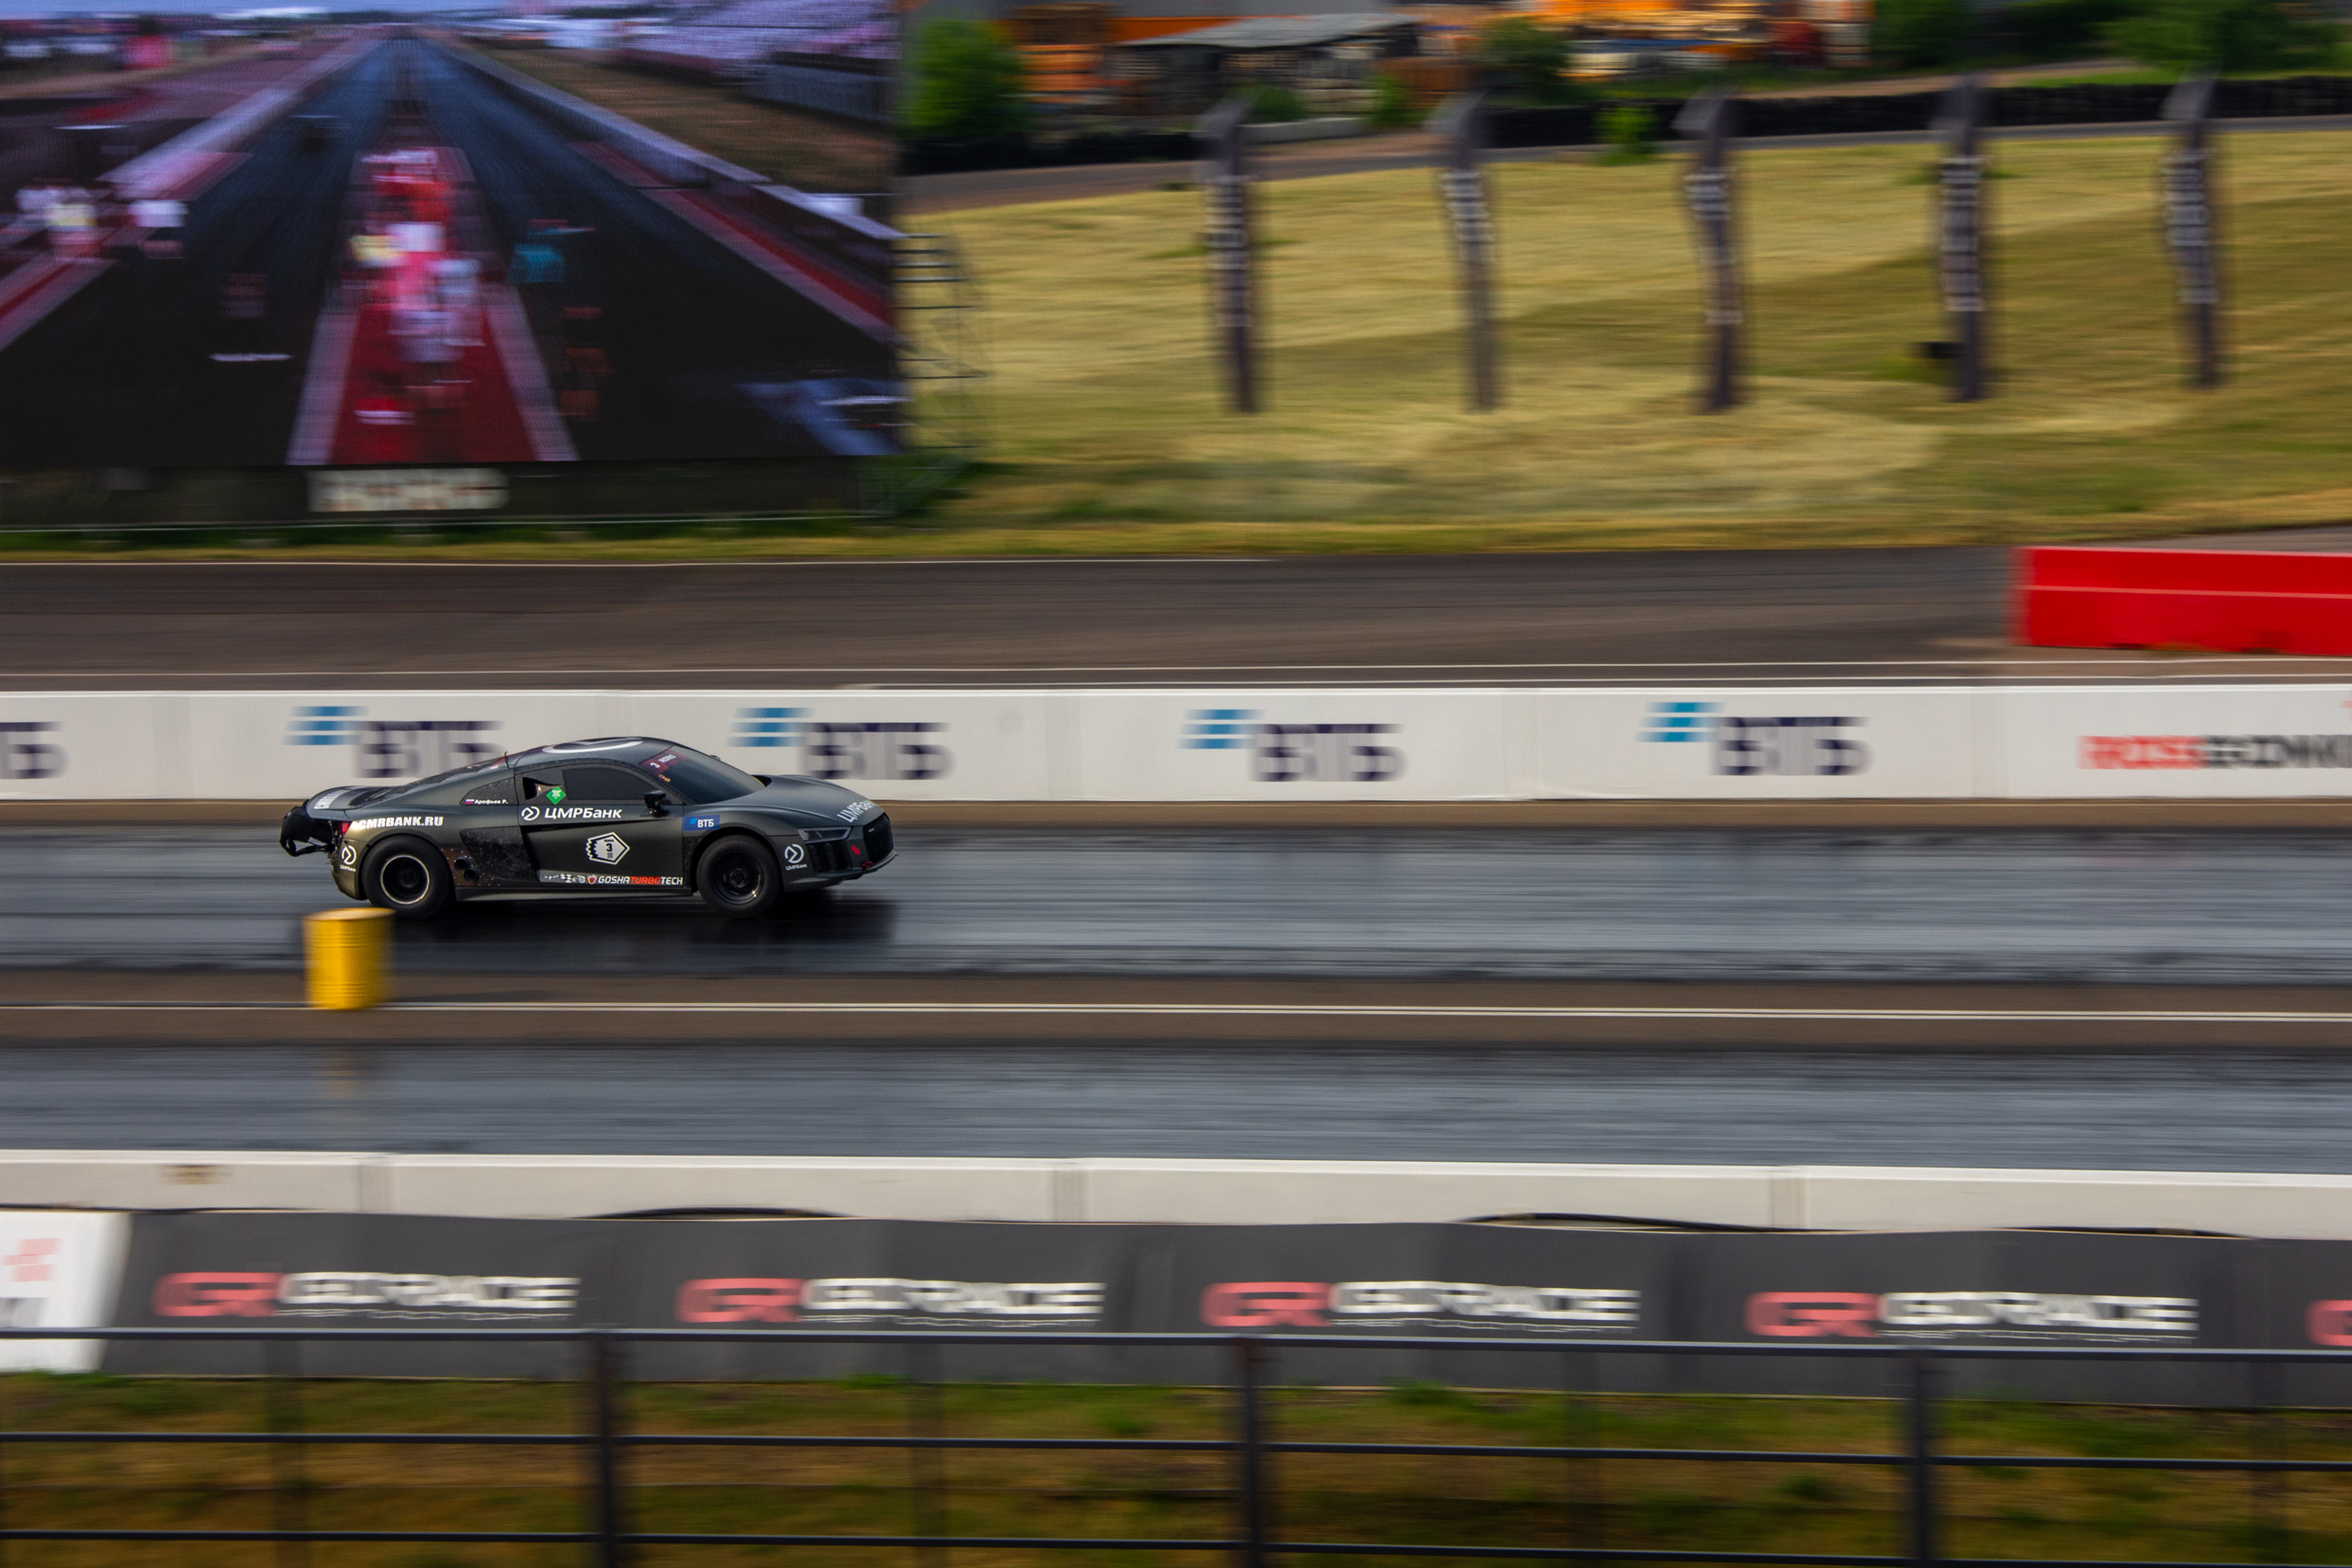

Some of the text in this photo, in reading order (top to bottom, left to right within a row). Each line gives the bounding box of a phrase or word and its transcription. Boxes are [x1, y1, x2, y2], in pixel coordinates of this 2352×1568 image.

[544, 807, 623, 819] ЦМРБанк
[357, 816, 444, 830] CMRBANK.RU
[697, 818, 715, 829] ВТБ
[605, 842, 613, 852] 3
[597, 875, 684, 886] GOSHATURBOTECH
